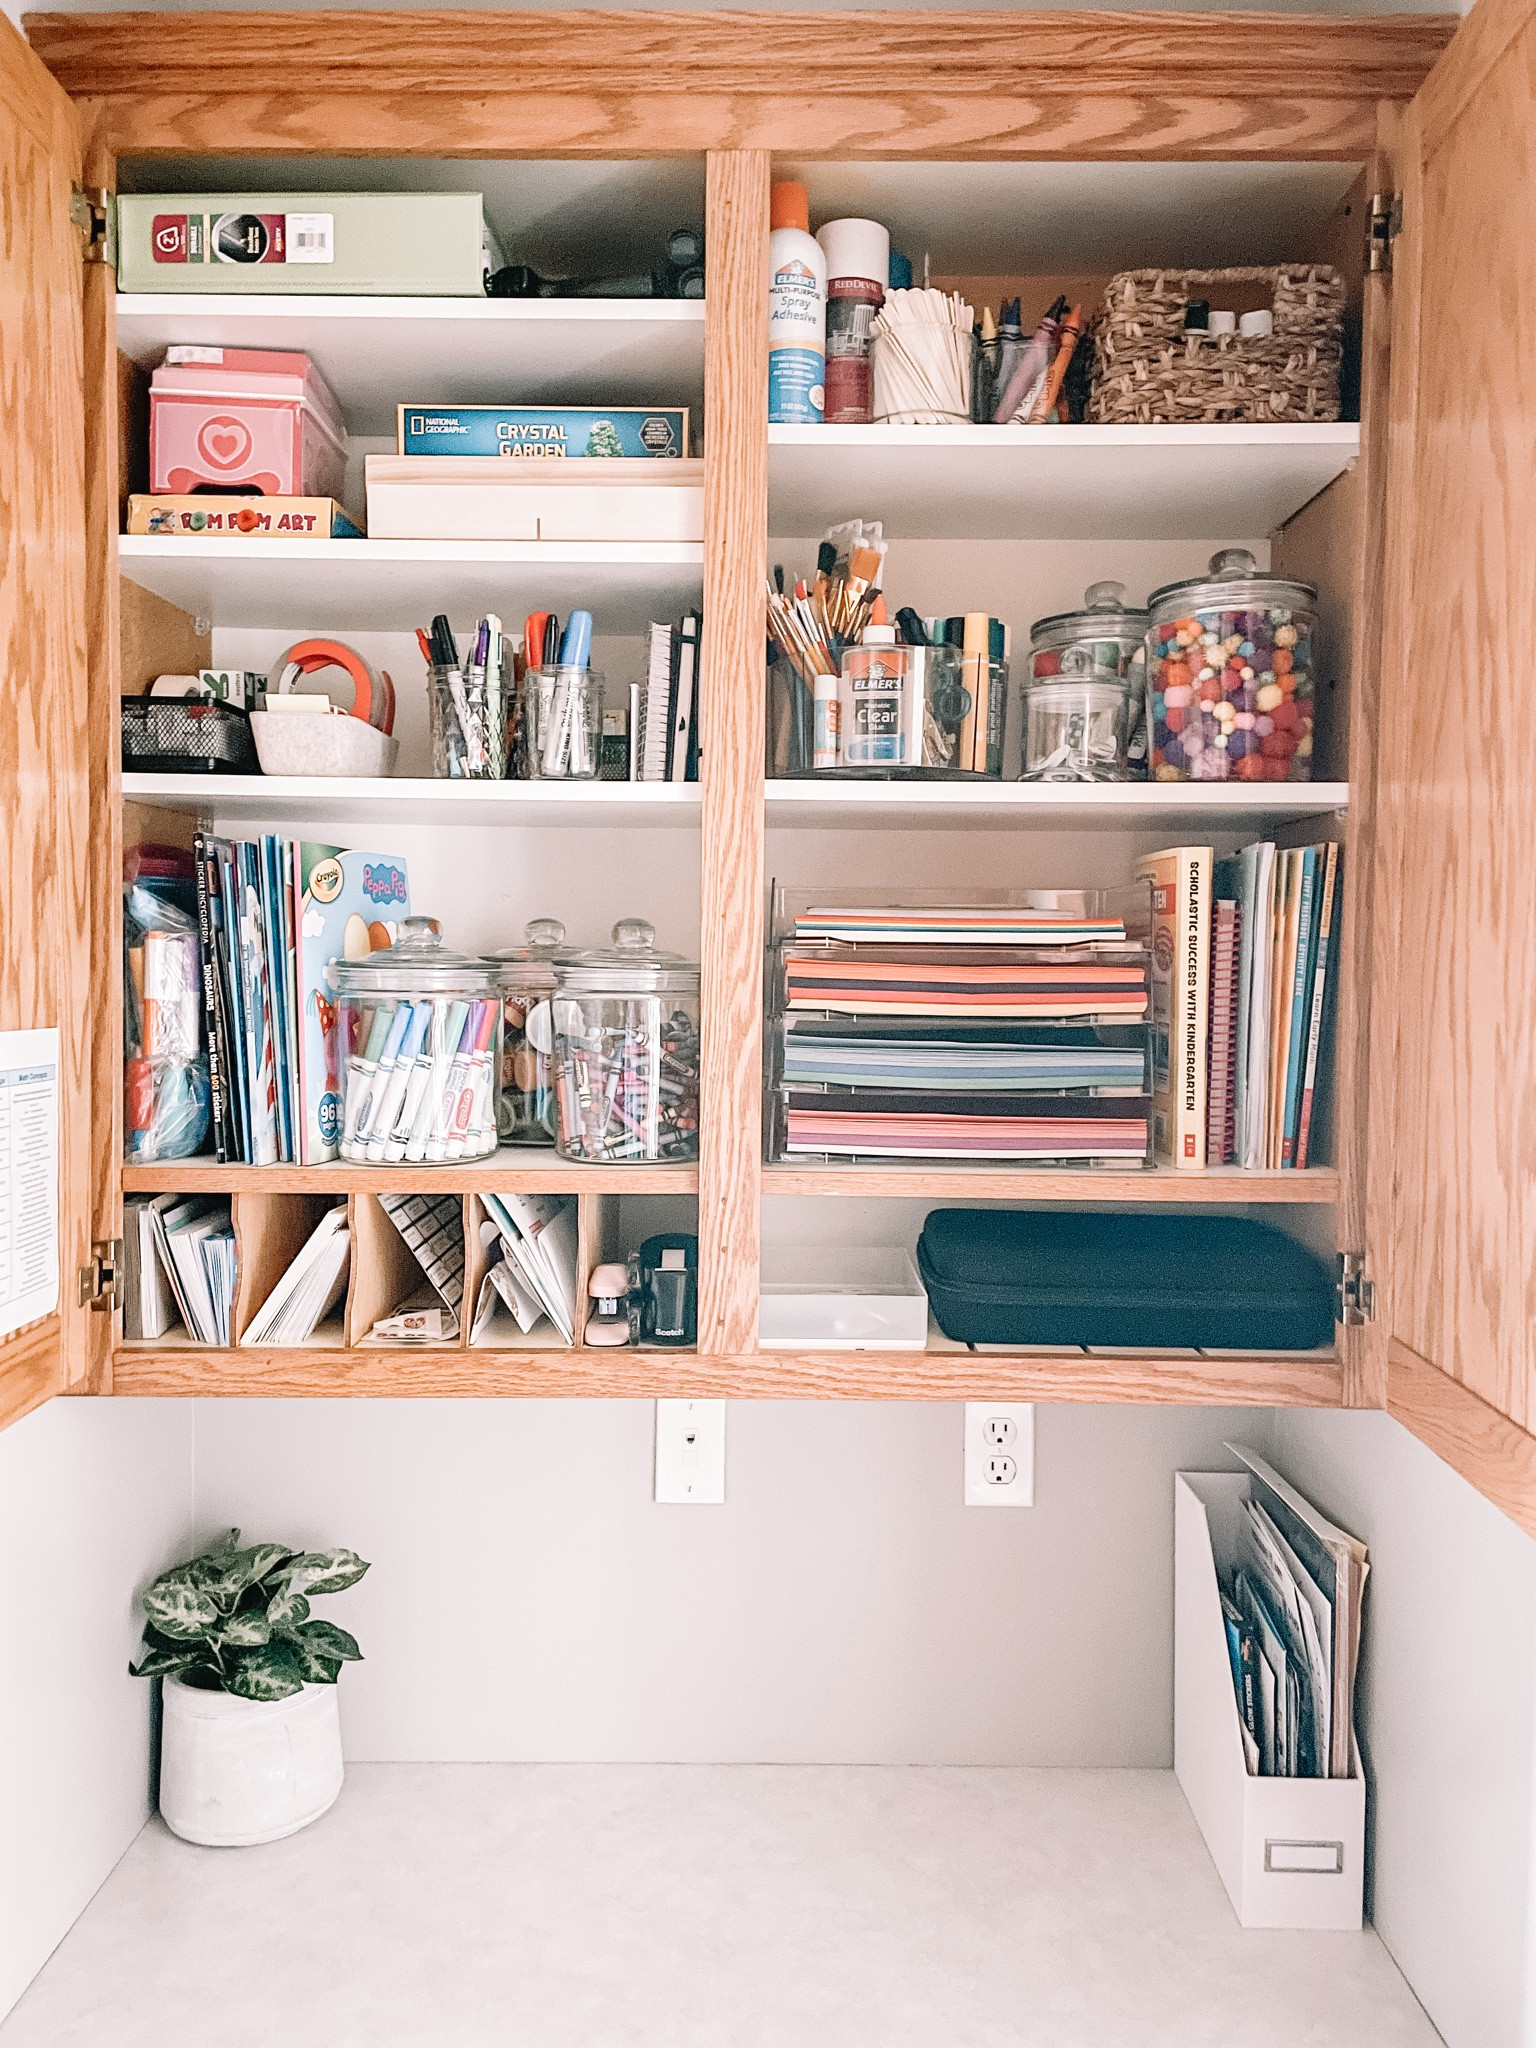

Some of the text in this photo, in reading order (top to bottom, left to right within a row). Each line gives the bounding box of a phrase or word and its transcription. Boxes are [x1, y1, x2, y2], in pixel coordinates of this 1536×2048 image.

[776, 274, 816, 288] ELMER'S
[769, 287, 821, 301] MULTI-PURPOSE
[780, 296, 811, 311] Spray
[772, 310, 817, 324] Adhesive
[425, 418, 459, 426] NATIONAL
[425, 425, 470, 434] GEOGRAPHIC
[496, 423, 568, 440] CRYSTAL
[499, 441, 566, 457] GARDEN
[277, 514, 317, 531] ART
[854, 678, 902, 691] ELMER'S
[857, 710, 897, 724] Clear
[869, 723, 885, 731] Glue
[560, 750, 568, 765] SIZE
[316, 868, 339, 883] Crayola
[364, 867, 407, 900] Peppa Pig
[1300, 901, 1310, 939] PRESCHOOL
[1322, 900, 1331, 929] Learning
[1297, 943, 1306, 974] ACTIVITY
[197, 861, 222, 1123] STICKER ENCYCLOPEDIA DINOSAURS More than 600 stickers
[1185, 861, 1199, 1111] SCHOLASTIC SUCCESS WITH KINDERGARTEN
[1295, 977, 1303, 997] BOOK
[1308, 994, 1321, 1065] Learn Early Math
[664, 1053, 688, 1073] Crayola
[320, 1104, 336, 1122] 96
[460, 1090, 473, 1127] Crayola
[655, 1328, 684, 1336] Scotch
[1247, 1706, 1255, 1730] GLOW
